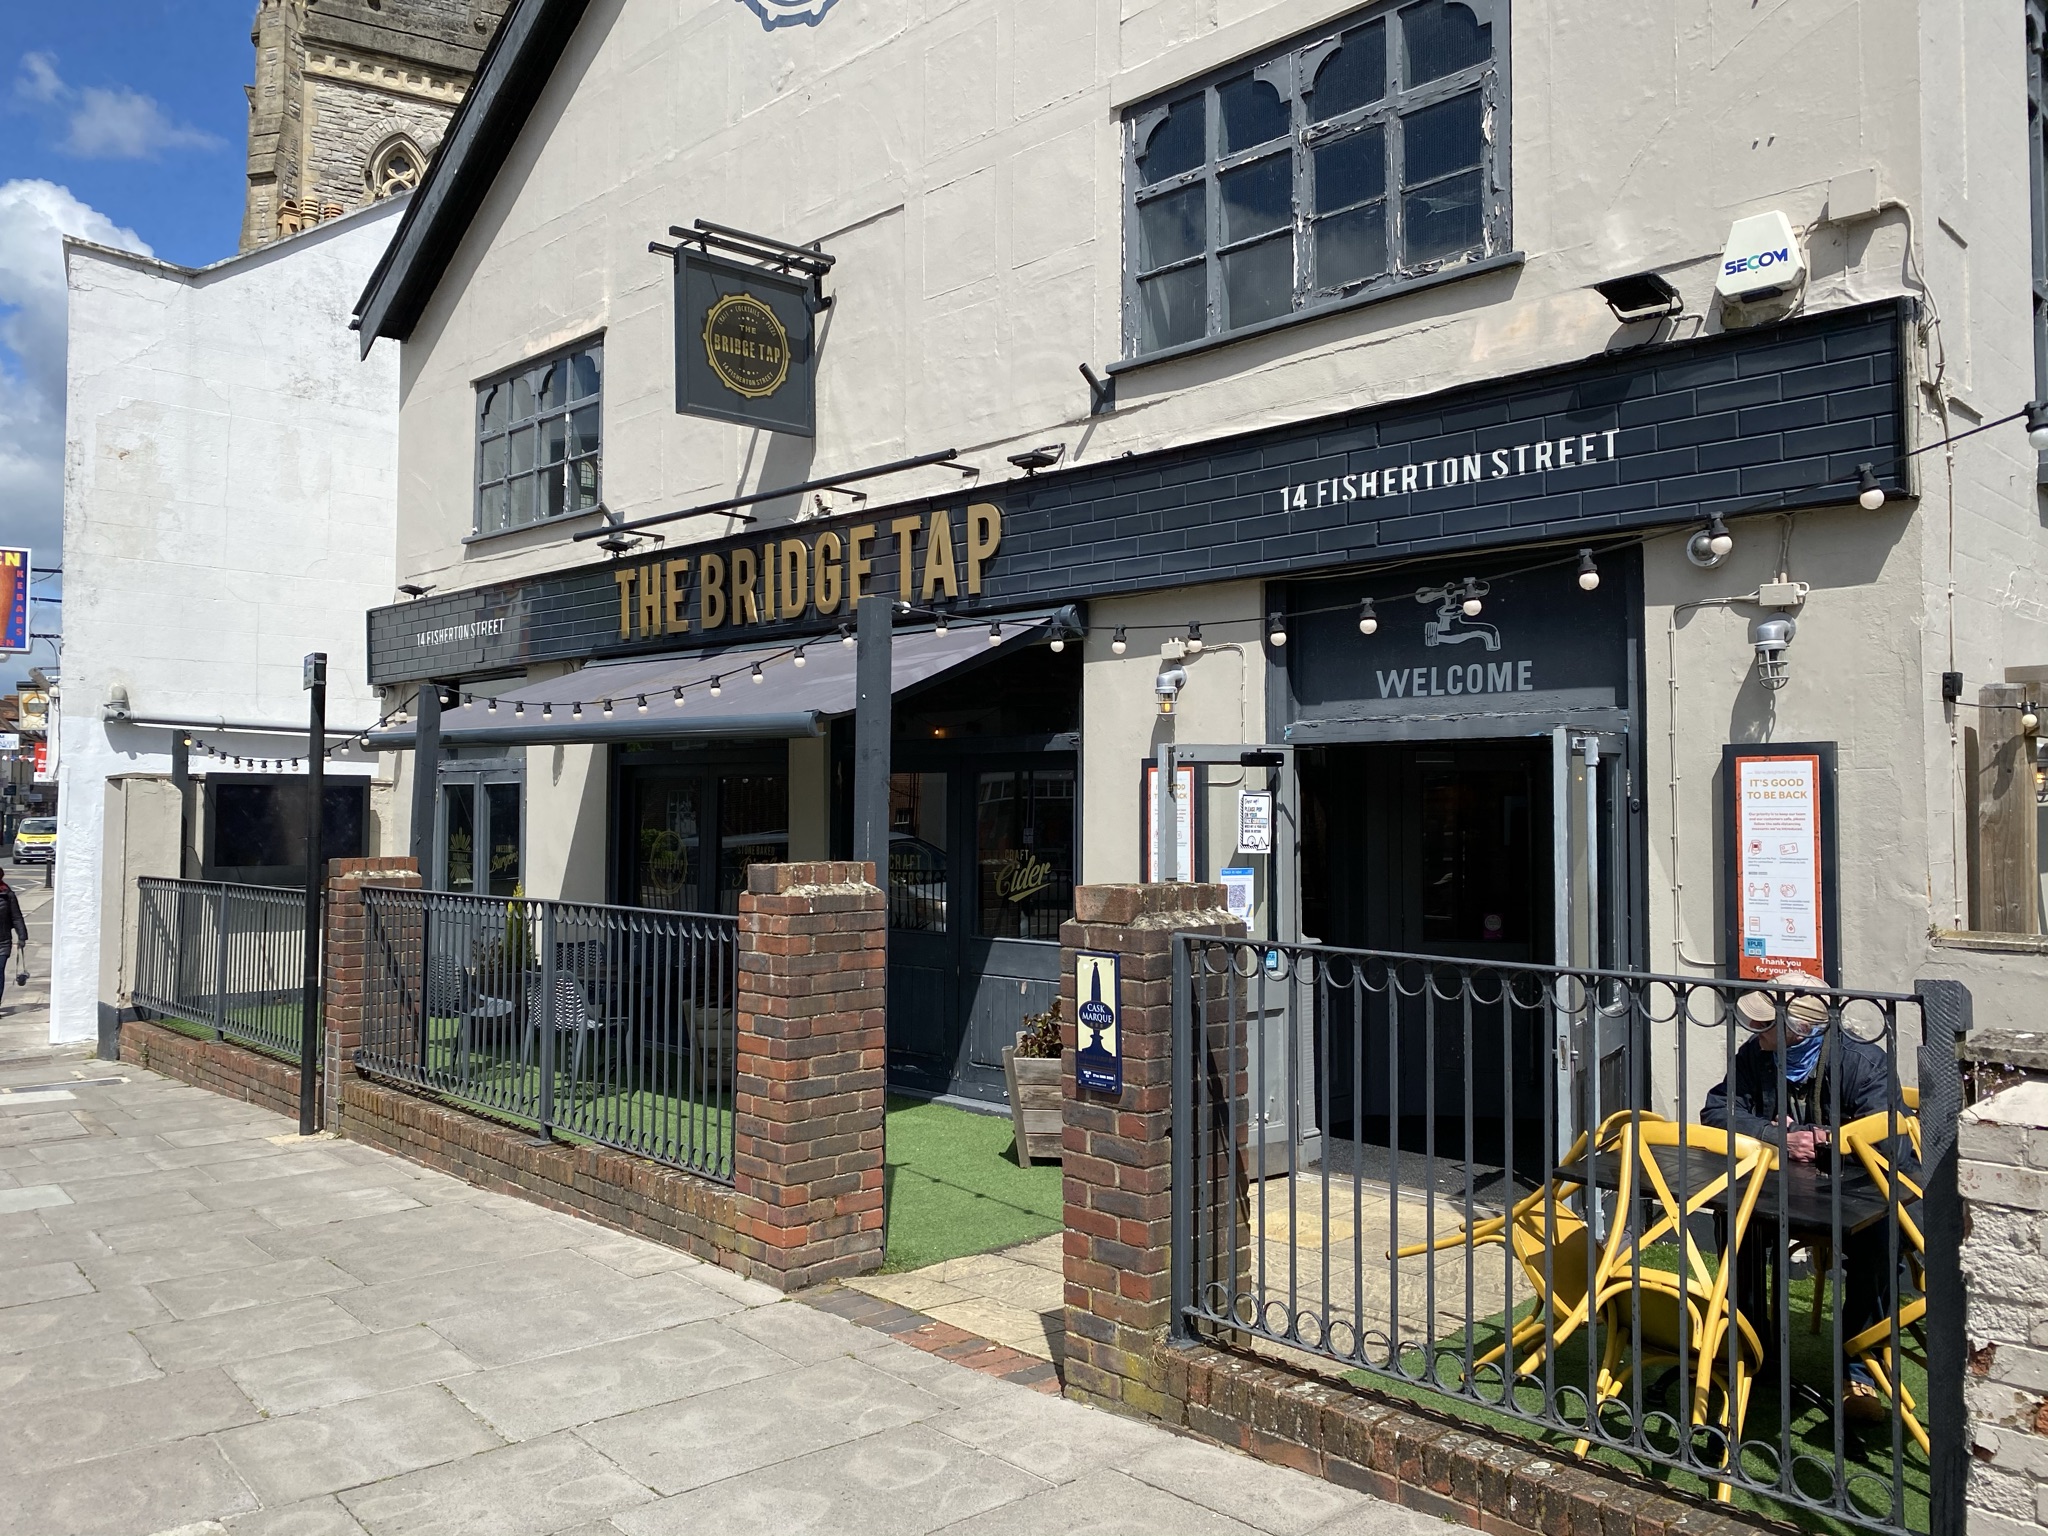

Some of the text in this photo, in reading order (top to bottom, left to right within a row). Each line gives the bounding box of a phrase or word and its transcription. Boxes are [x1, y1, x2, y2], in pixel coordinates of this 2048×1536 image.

[1725, 248, 1788, 275] SECOM
[735, 305, 760, 318] COCKTAILS
[766, 320, 777, 337] PIZZA
[739, 324, 757, 335] THE
[714, 333, 781, 364] BRIDGE TAP
[722, 362, 774, 386] 14 FISHERTON STREET
[1280, 428, 1620, 513] 14 FISHERTON STREET
[0, 551, 21, 567] N
[614, 502, 1002, 640] THE BRIDGE TAP
[16, 570, 24, 636] KEBABS
[417, 618, 505, 647] 14 FISHERTON STREET
[1376, 660, 1534, 699] WELCOME
[1750, 779, 1804, 787] IT'S GOOD
[1747, 791, 1808, 800] TO BE BACK
[890, 854, 921, 870] CRAFT
[1003, 849, 1029, 861] CRAFT
[993, 854, 1052, 897] Cider
[1755, 965, 1768, 973] for
[1760, 957, 1785, 965] Thank
[1082, 1011, 1112, 1024] MARQUE
[1087, 1003, 1106, 1014] CASK
